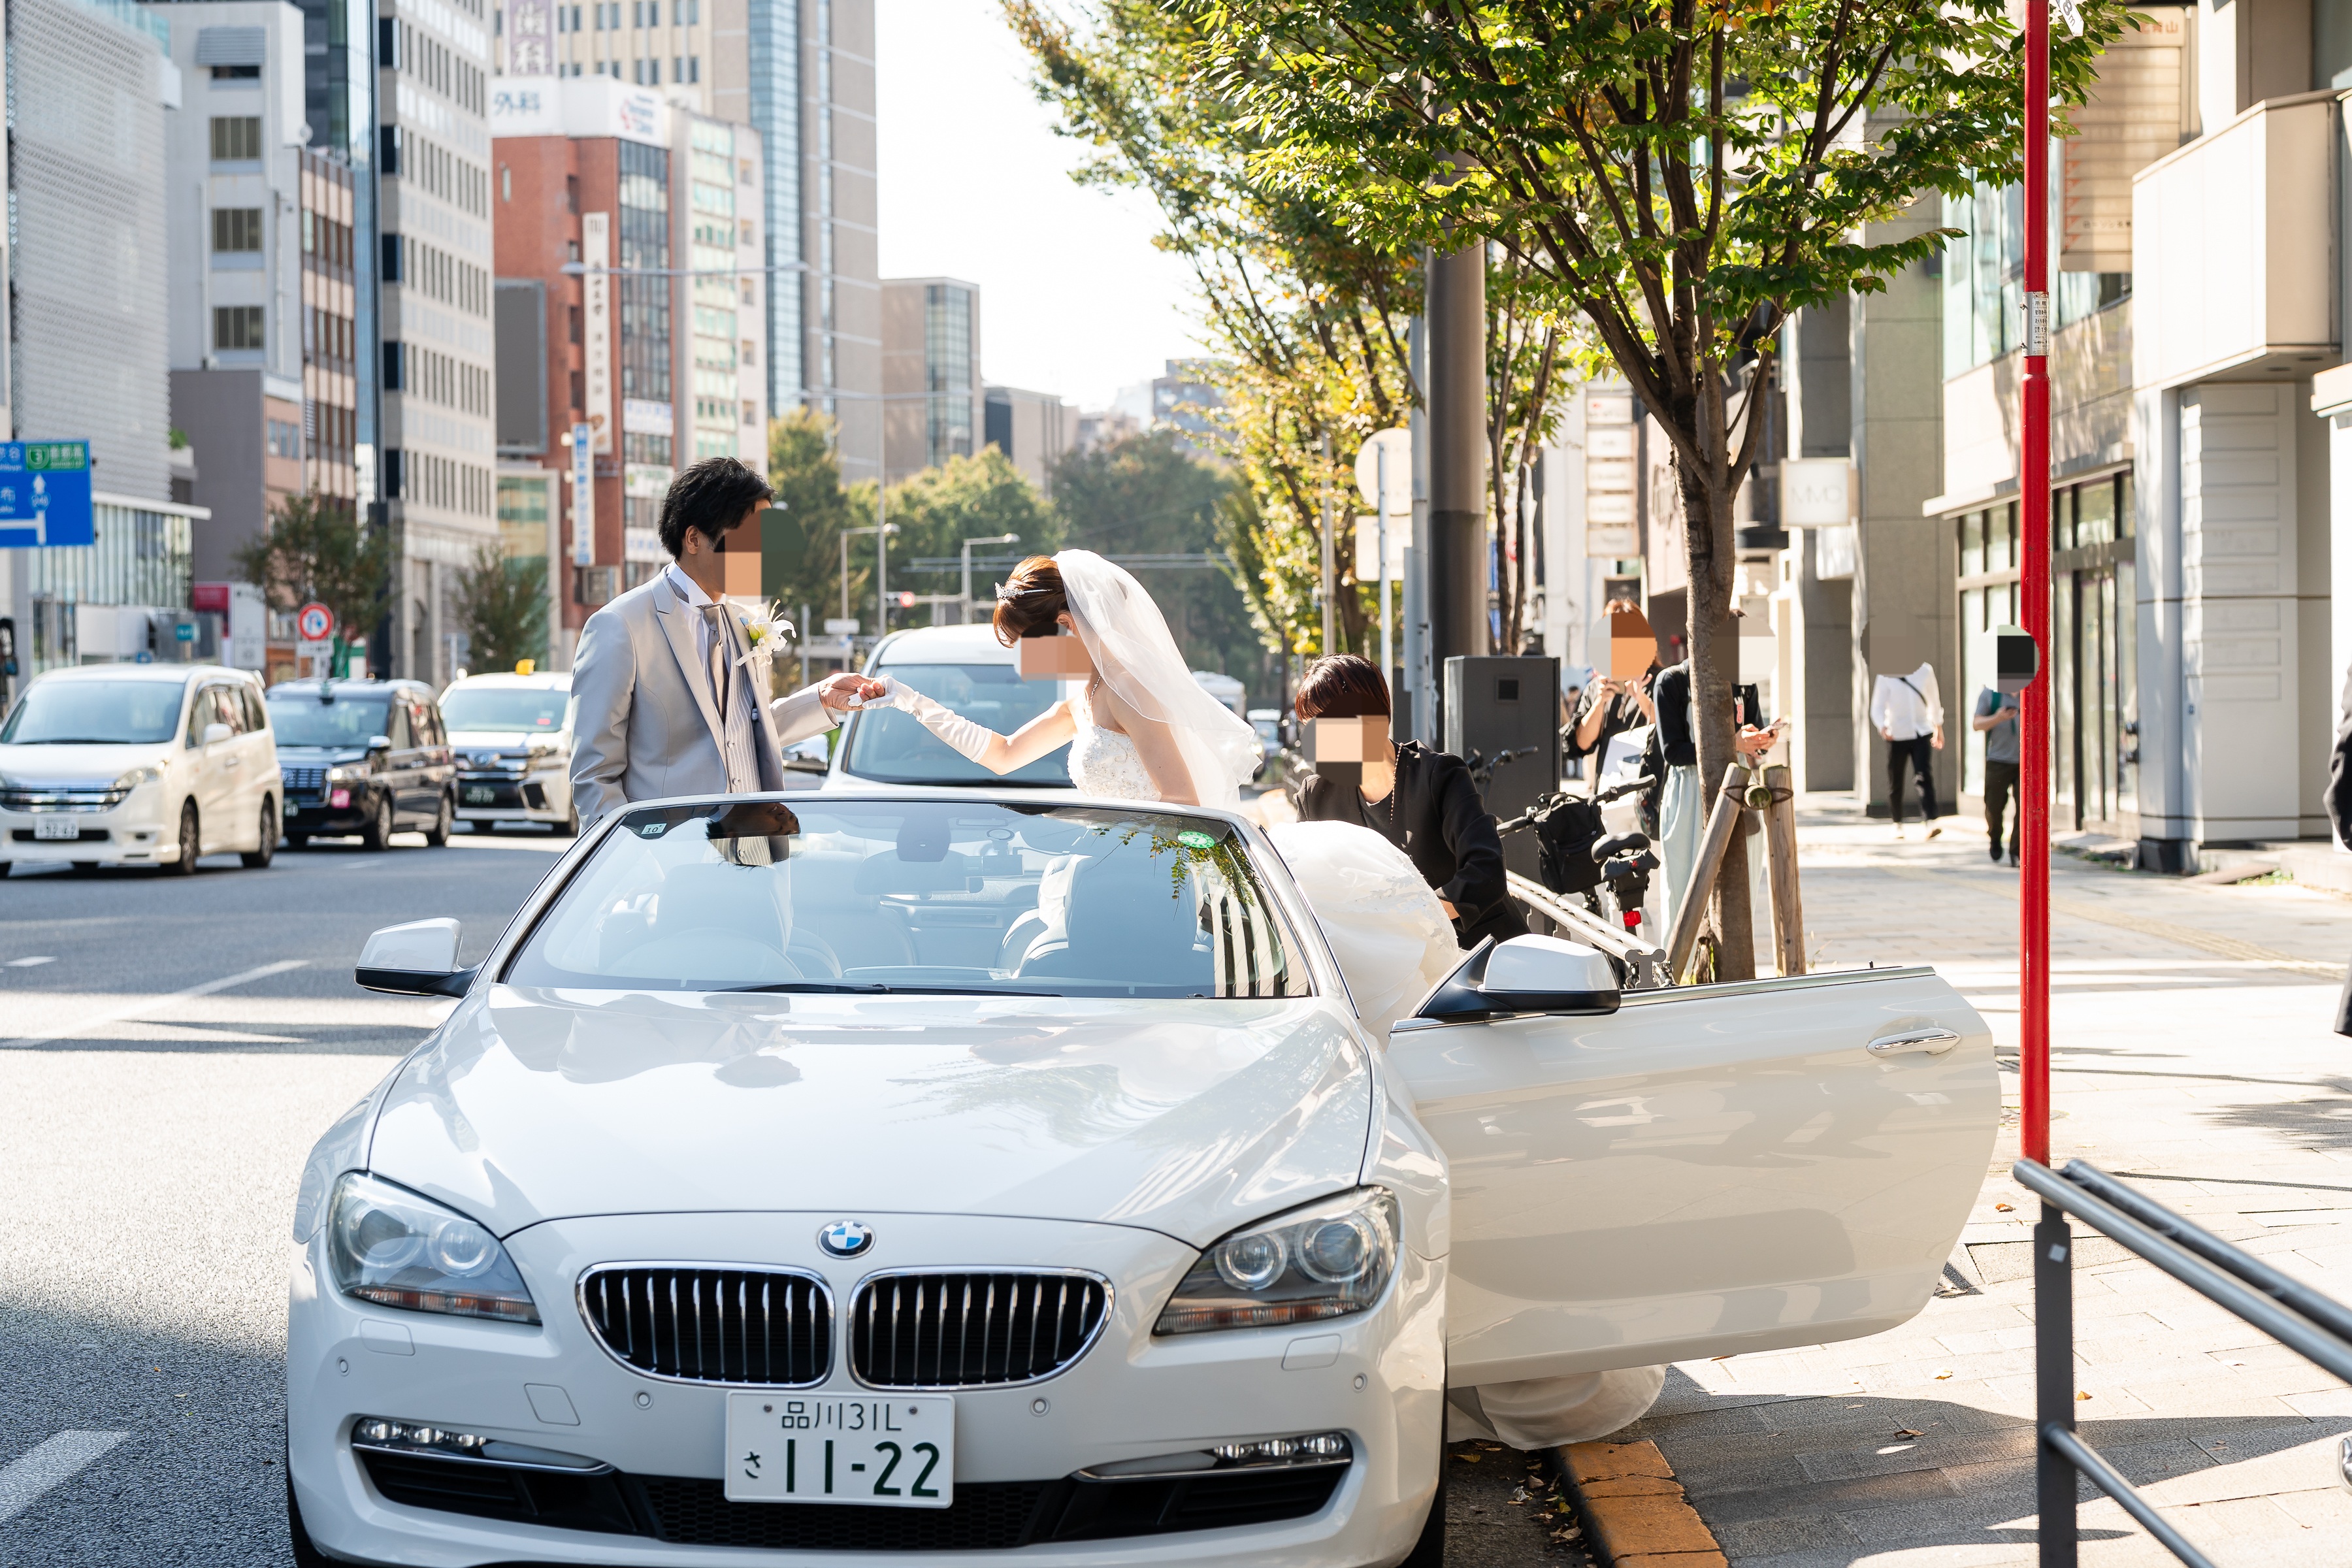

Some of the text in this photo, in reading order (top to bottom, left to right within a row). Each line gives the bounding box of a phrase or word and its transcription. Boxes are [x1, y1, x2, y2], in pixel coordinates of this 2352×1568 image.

[494, 90, 540, 116] 外科
[743, 1439, 939, 1497] さ 11-22
